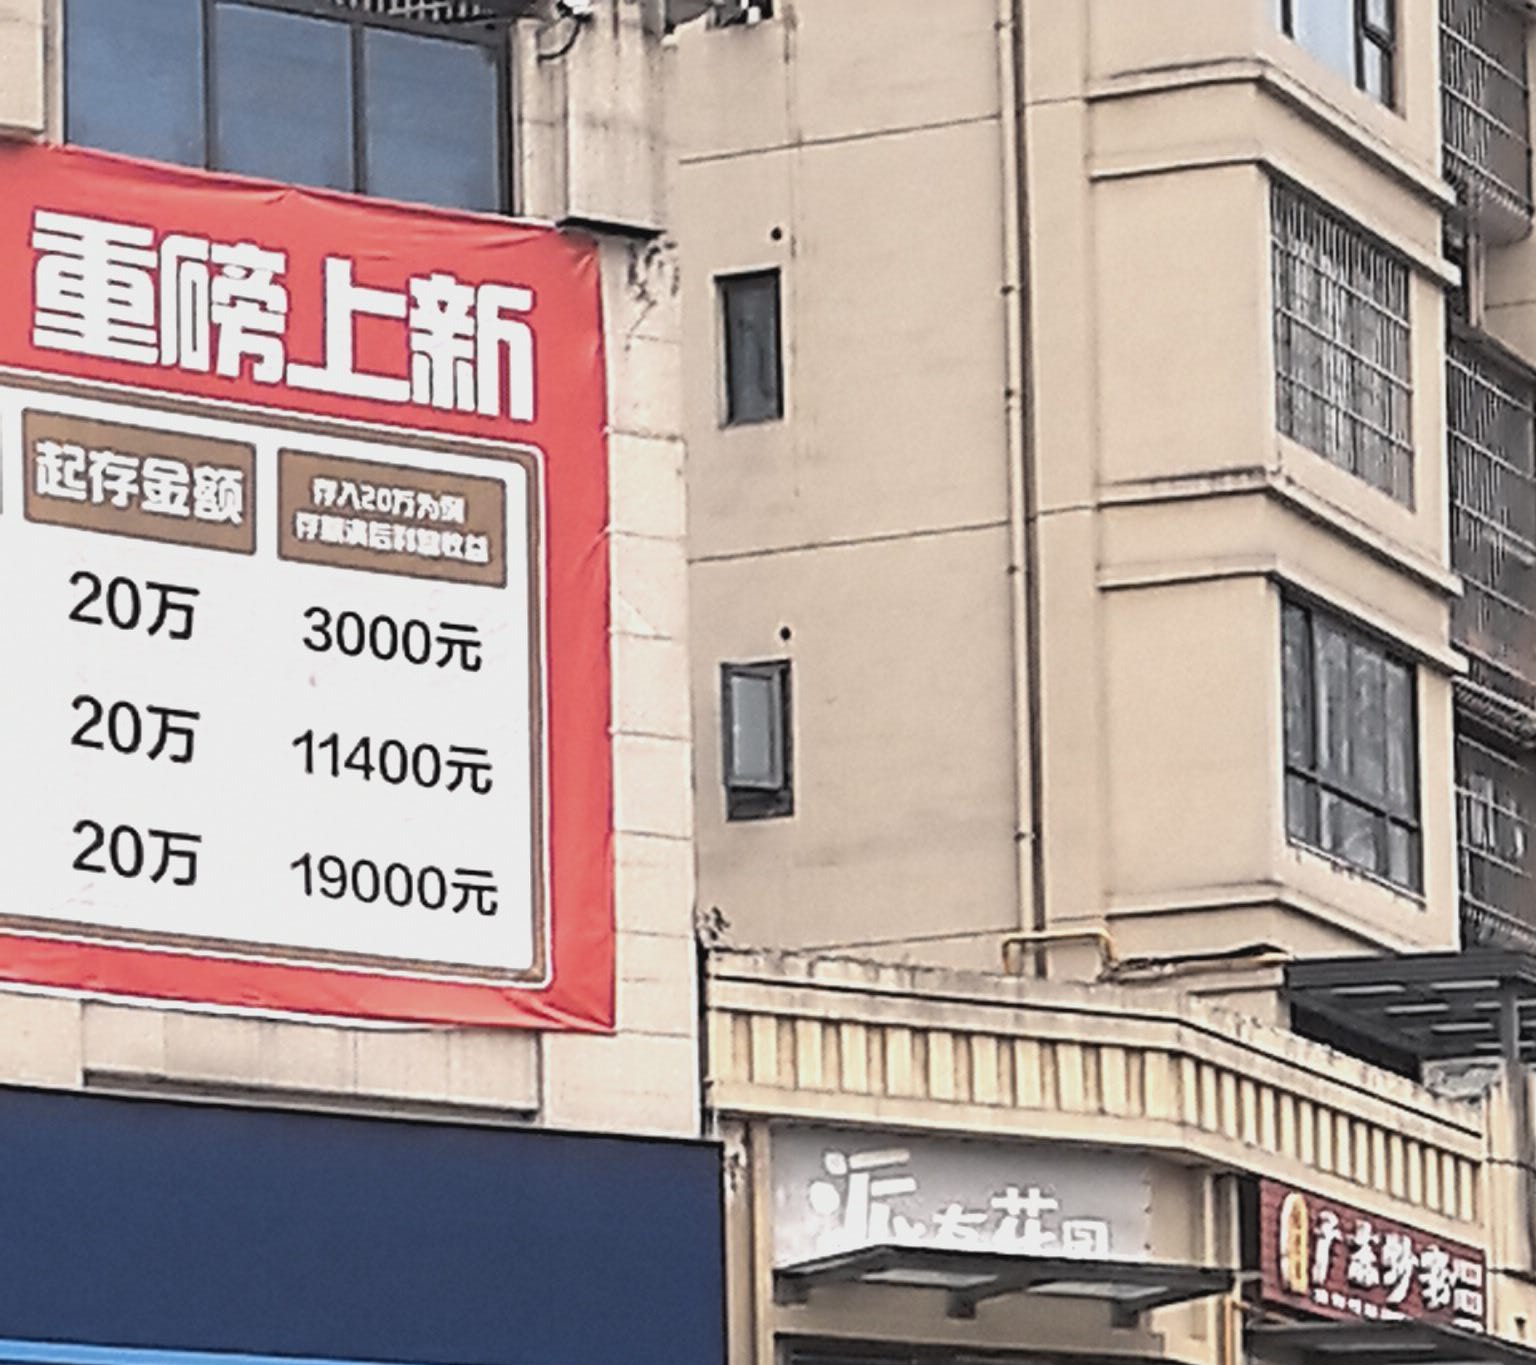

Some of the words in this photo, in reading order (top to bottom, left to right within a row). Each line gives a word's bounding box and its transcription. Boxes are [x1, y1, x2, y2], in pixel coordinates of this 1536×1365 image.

[32, 209, 537, 422] 重磅上新
[34, 439, 245, 527] 起存金额
[68, 571, 200, 642] 20万
[302, 607, 482, 673] 3000元
[70, 696, 200, 764] 20万
[291, 729, 494, 795] 11400元
[72, 820, 202, 887] 20万
[290, 853, 498, 917] 19000元
